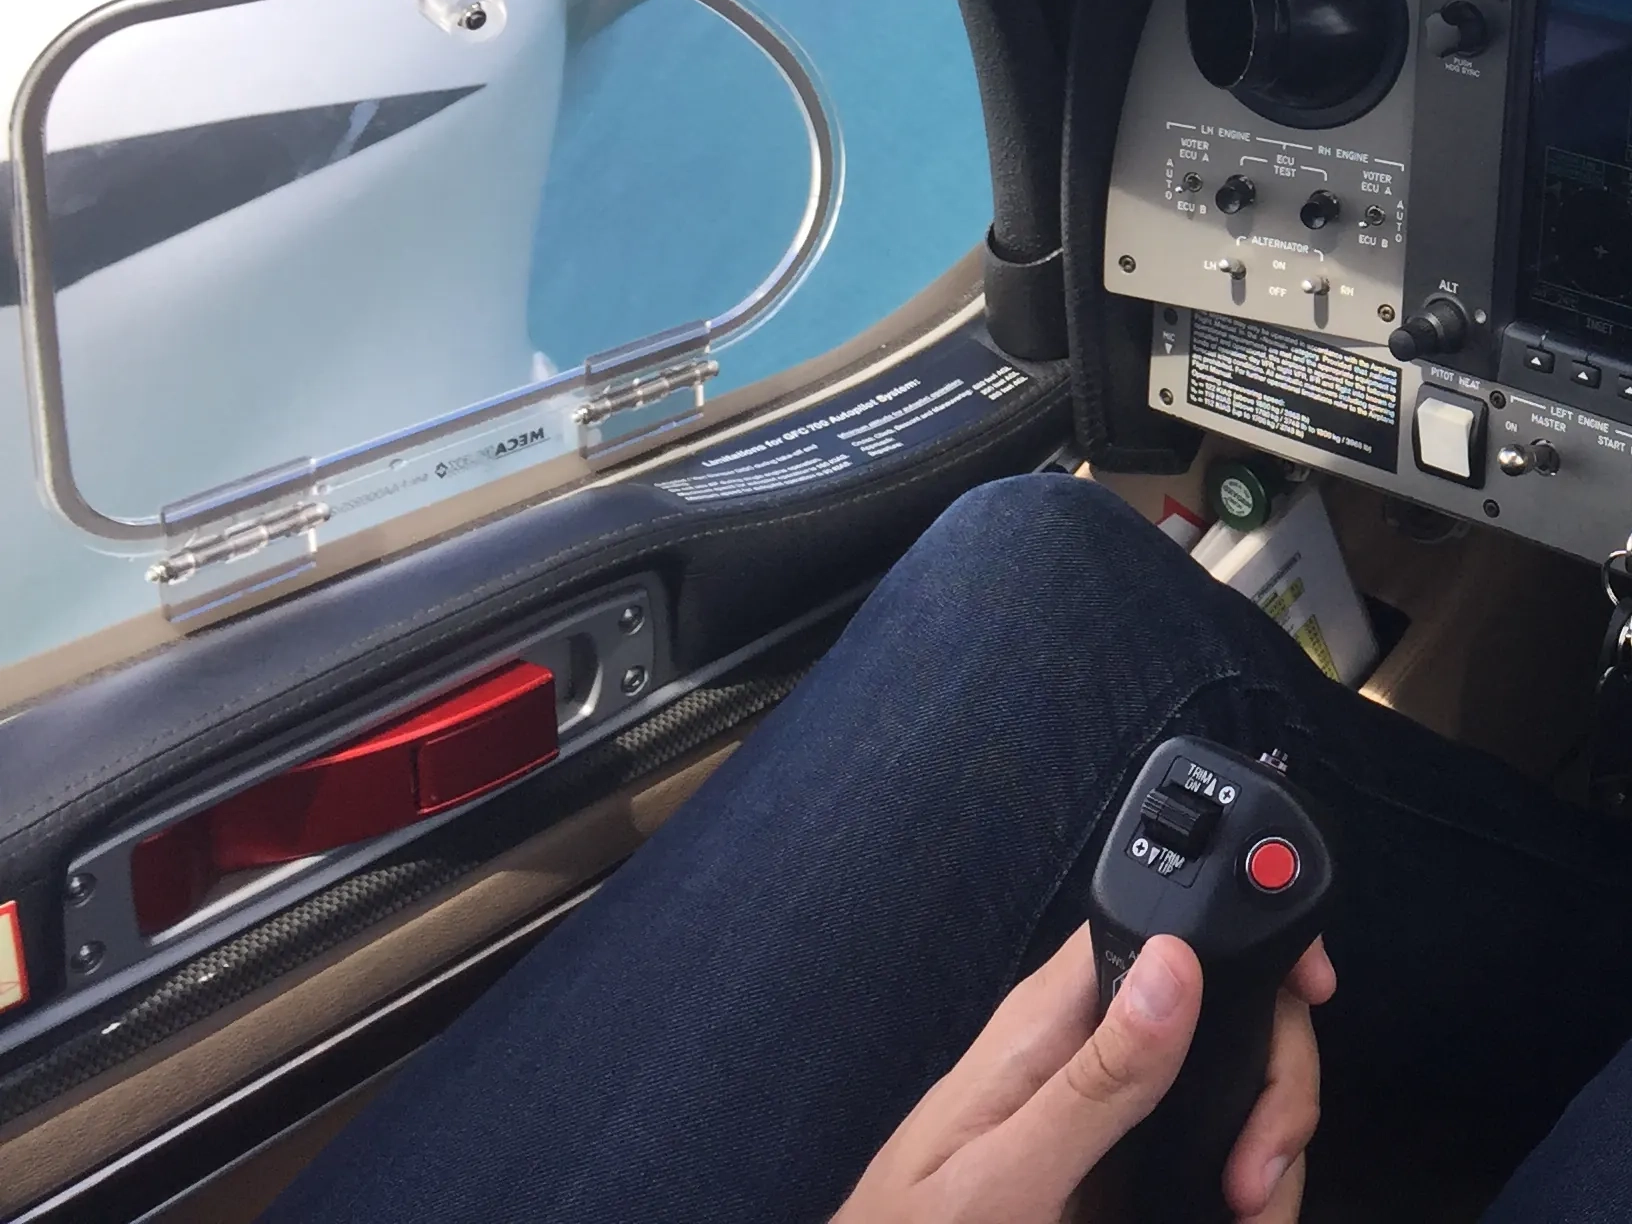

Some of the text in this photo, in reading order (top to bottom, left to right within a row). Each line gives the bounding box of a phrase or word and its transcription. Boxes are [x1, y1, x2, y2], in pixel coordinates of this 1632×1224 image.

[1252, 236, 1310, 255] ALTERNATOR
[1431, 367, 1454, 382] PITOT
[1531, 412, 1568, 435] MASTER
[1597, 435, 1627, 454] START
[1187, 762, 1214, 785] TRIM
[1158, 845, 1187, 869] TRIM
